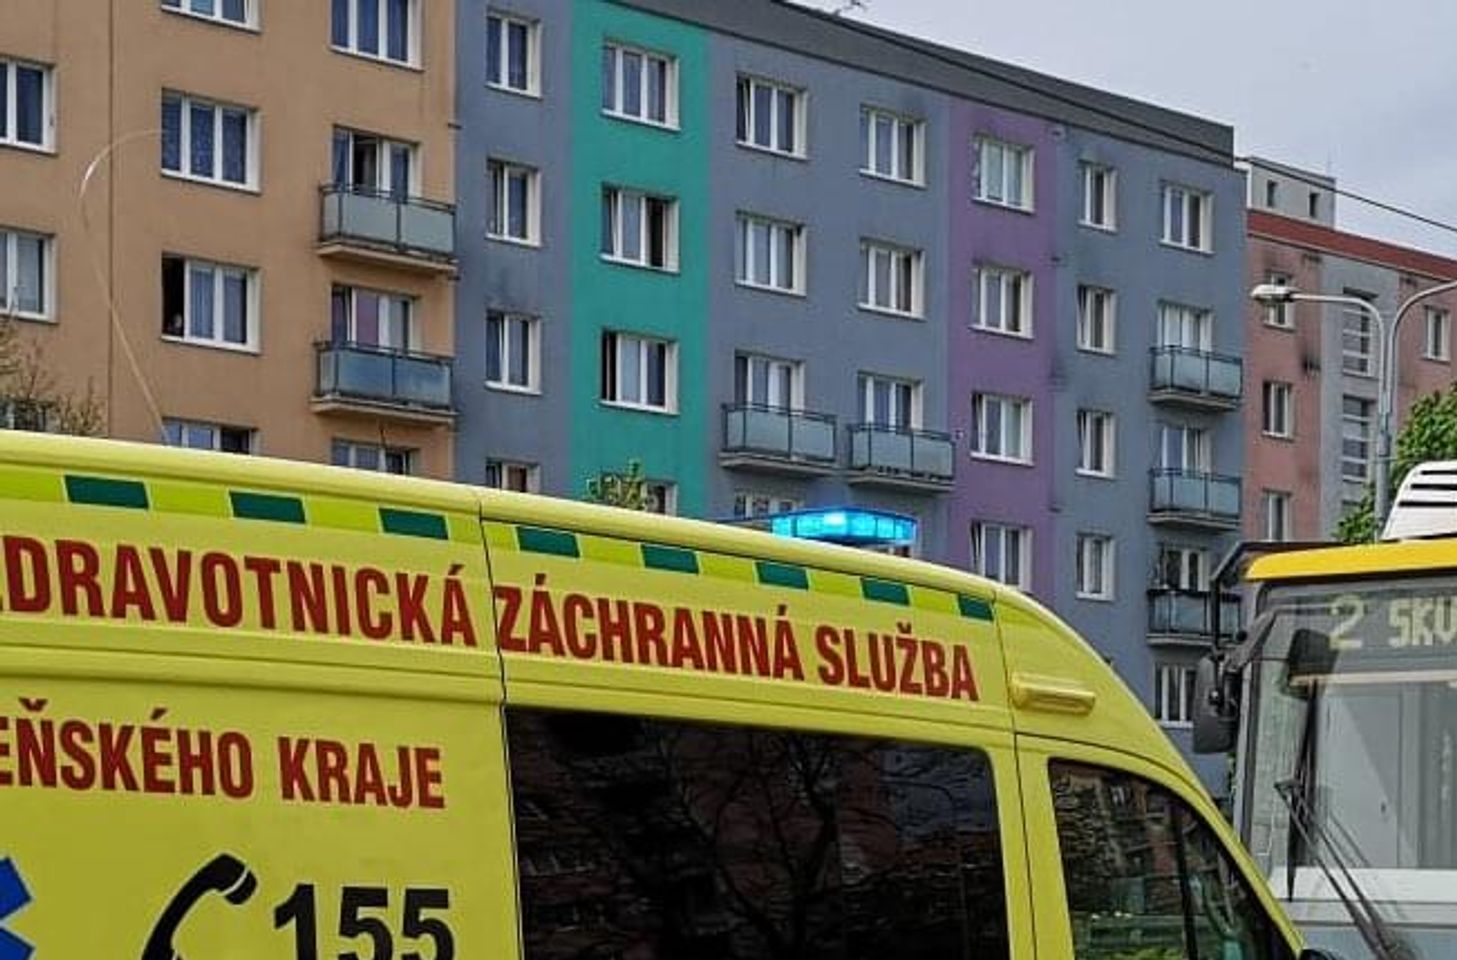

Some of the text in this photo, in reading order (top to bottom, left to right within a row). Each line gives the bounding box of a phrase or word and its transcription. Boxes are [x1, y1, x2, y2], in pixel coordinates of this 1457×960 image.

[0, 534, 979, 702] DRAVOTNICKÁ ZÁCHRANNÁ SLUŽBA
[1329, 594, 1364, 650] 2
[277, 736, 446, 809] KRAJE
